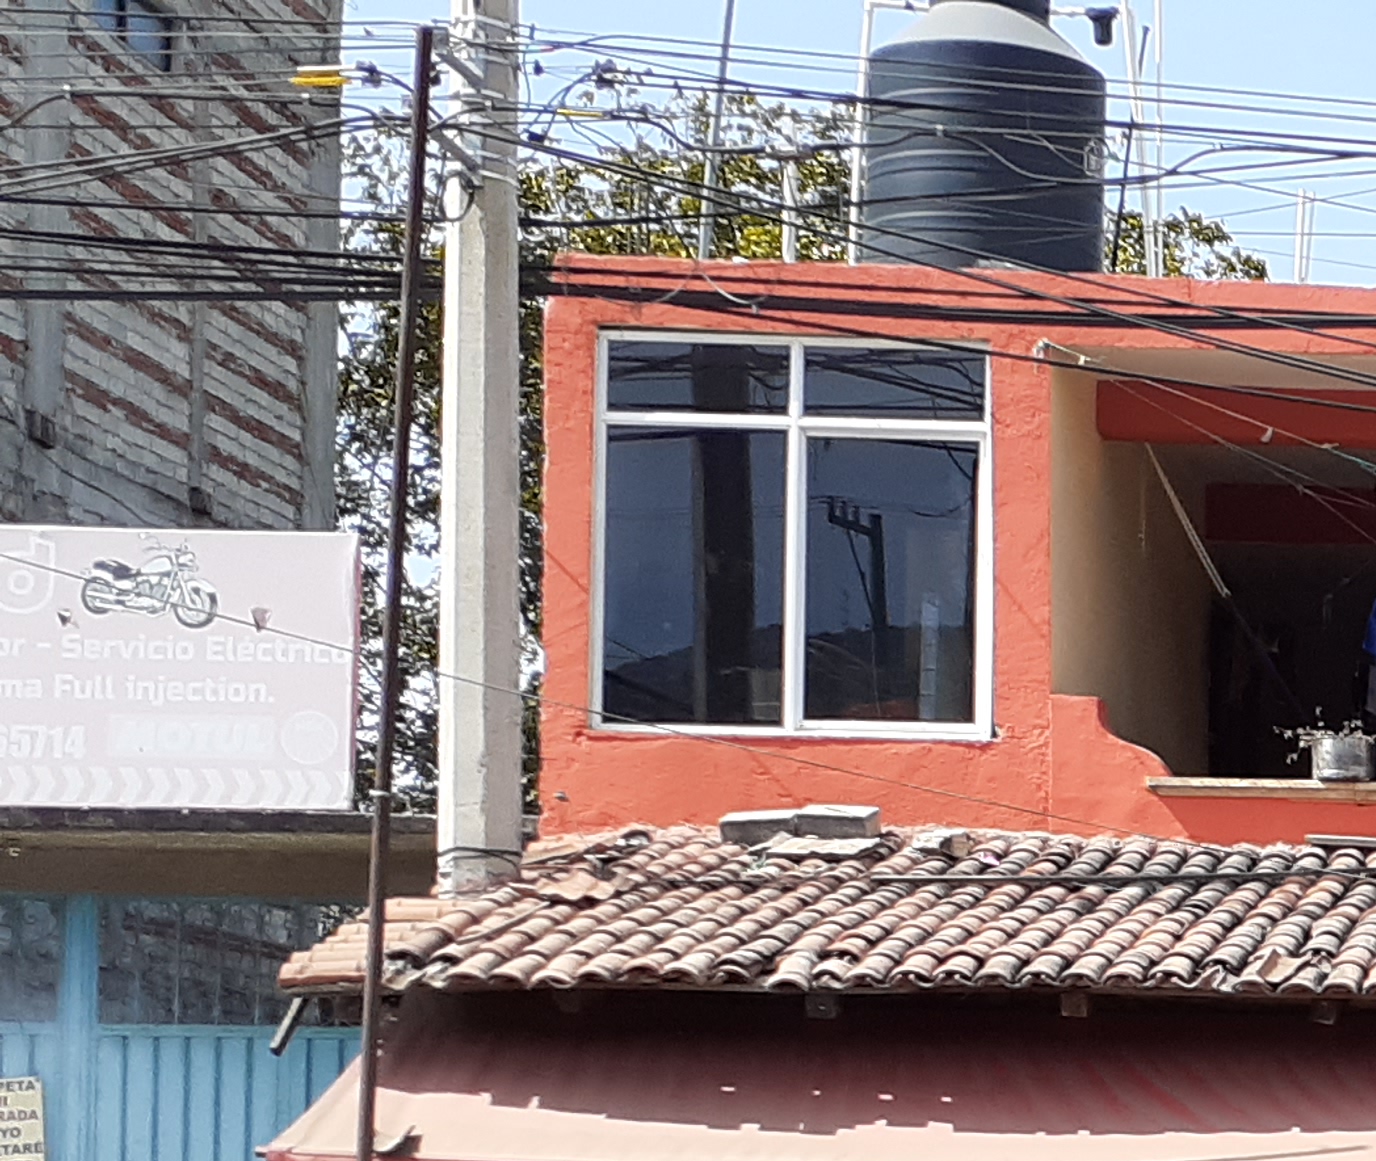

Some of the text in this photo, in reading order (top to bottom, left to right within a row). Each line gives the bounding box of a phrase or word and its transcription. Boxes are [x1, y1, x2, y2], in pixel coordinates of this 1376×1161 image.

[61, 635, 193, 662] Servicio
[55, 674, 113, 700] Full
[125, 675, 275, 706] injection.
[0, 1081, 35, 1092] ETA
